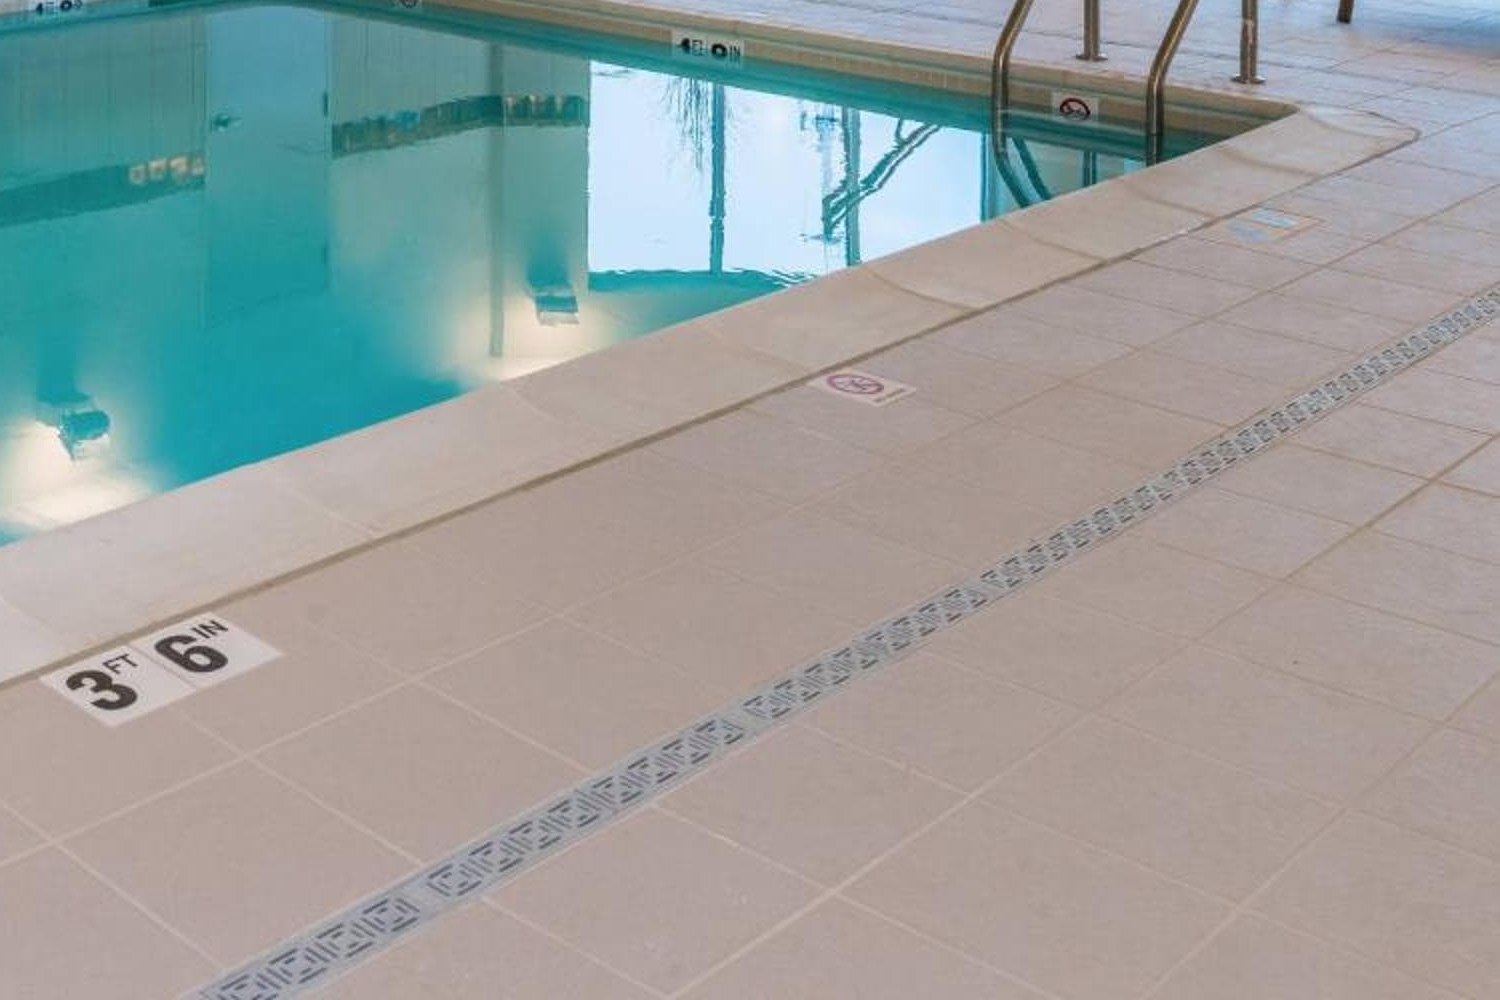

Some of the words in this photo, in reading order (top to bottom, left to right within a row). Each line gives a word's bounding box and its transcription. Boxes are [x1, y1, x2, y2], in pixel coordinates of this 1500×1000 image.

[191, 620, 229, 639] IN
[102, 653, 139, 675] FT
[154, 635, 229, 673] 6
[66, 670, 138, 710] 3
